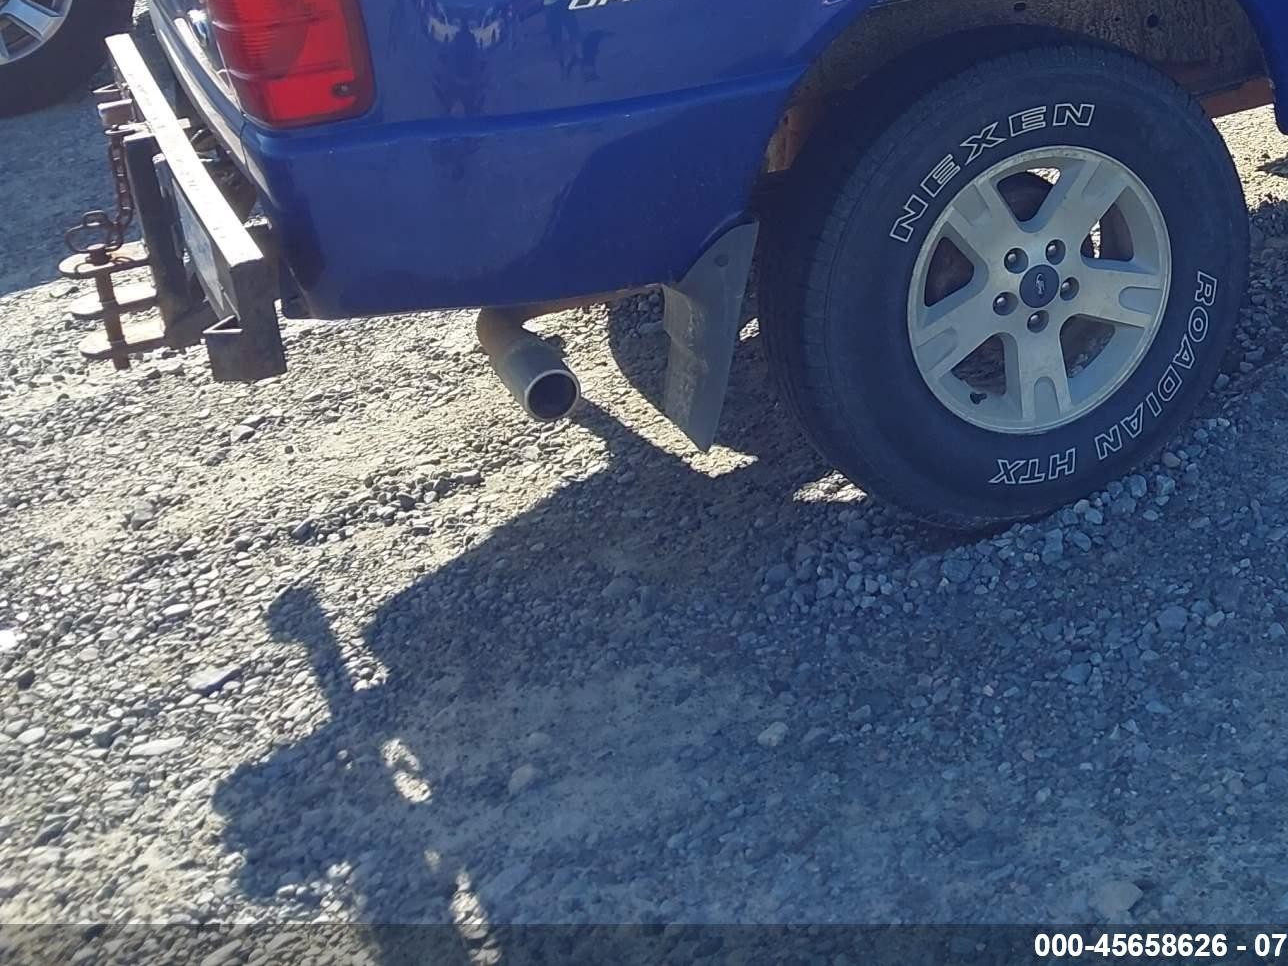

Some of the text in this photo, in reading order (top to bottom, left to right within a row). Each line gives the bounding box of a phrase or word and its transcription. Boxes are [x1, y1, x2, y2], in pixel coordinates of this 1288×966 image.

[889, 103, 1095, 242] NEXEN
[988, 271, 1217, 484] ROADIAN HTX
